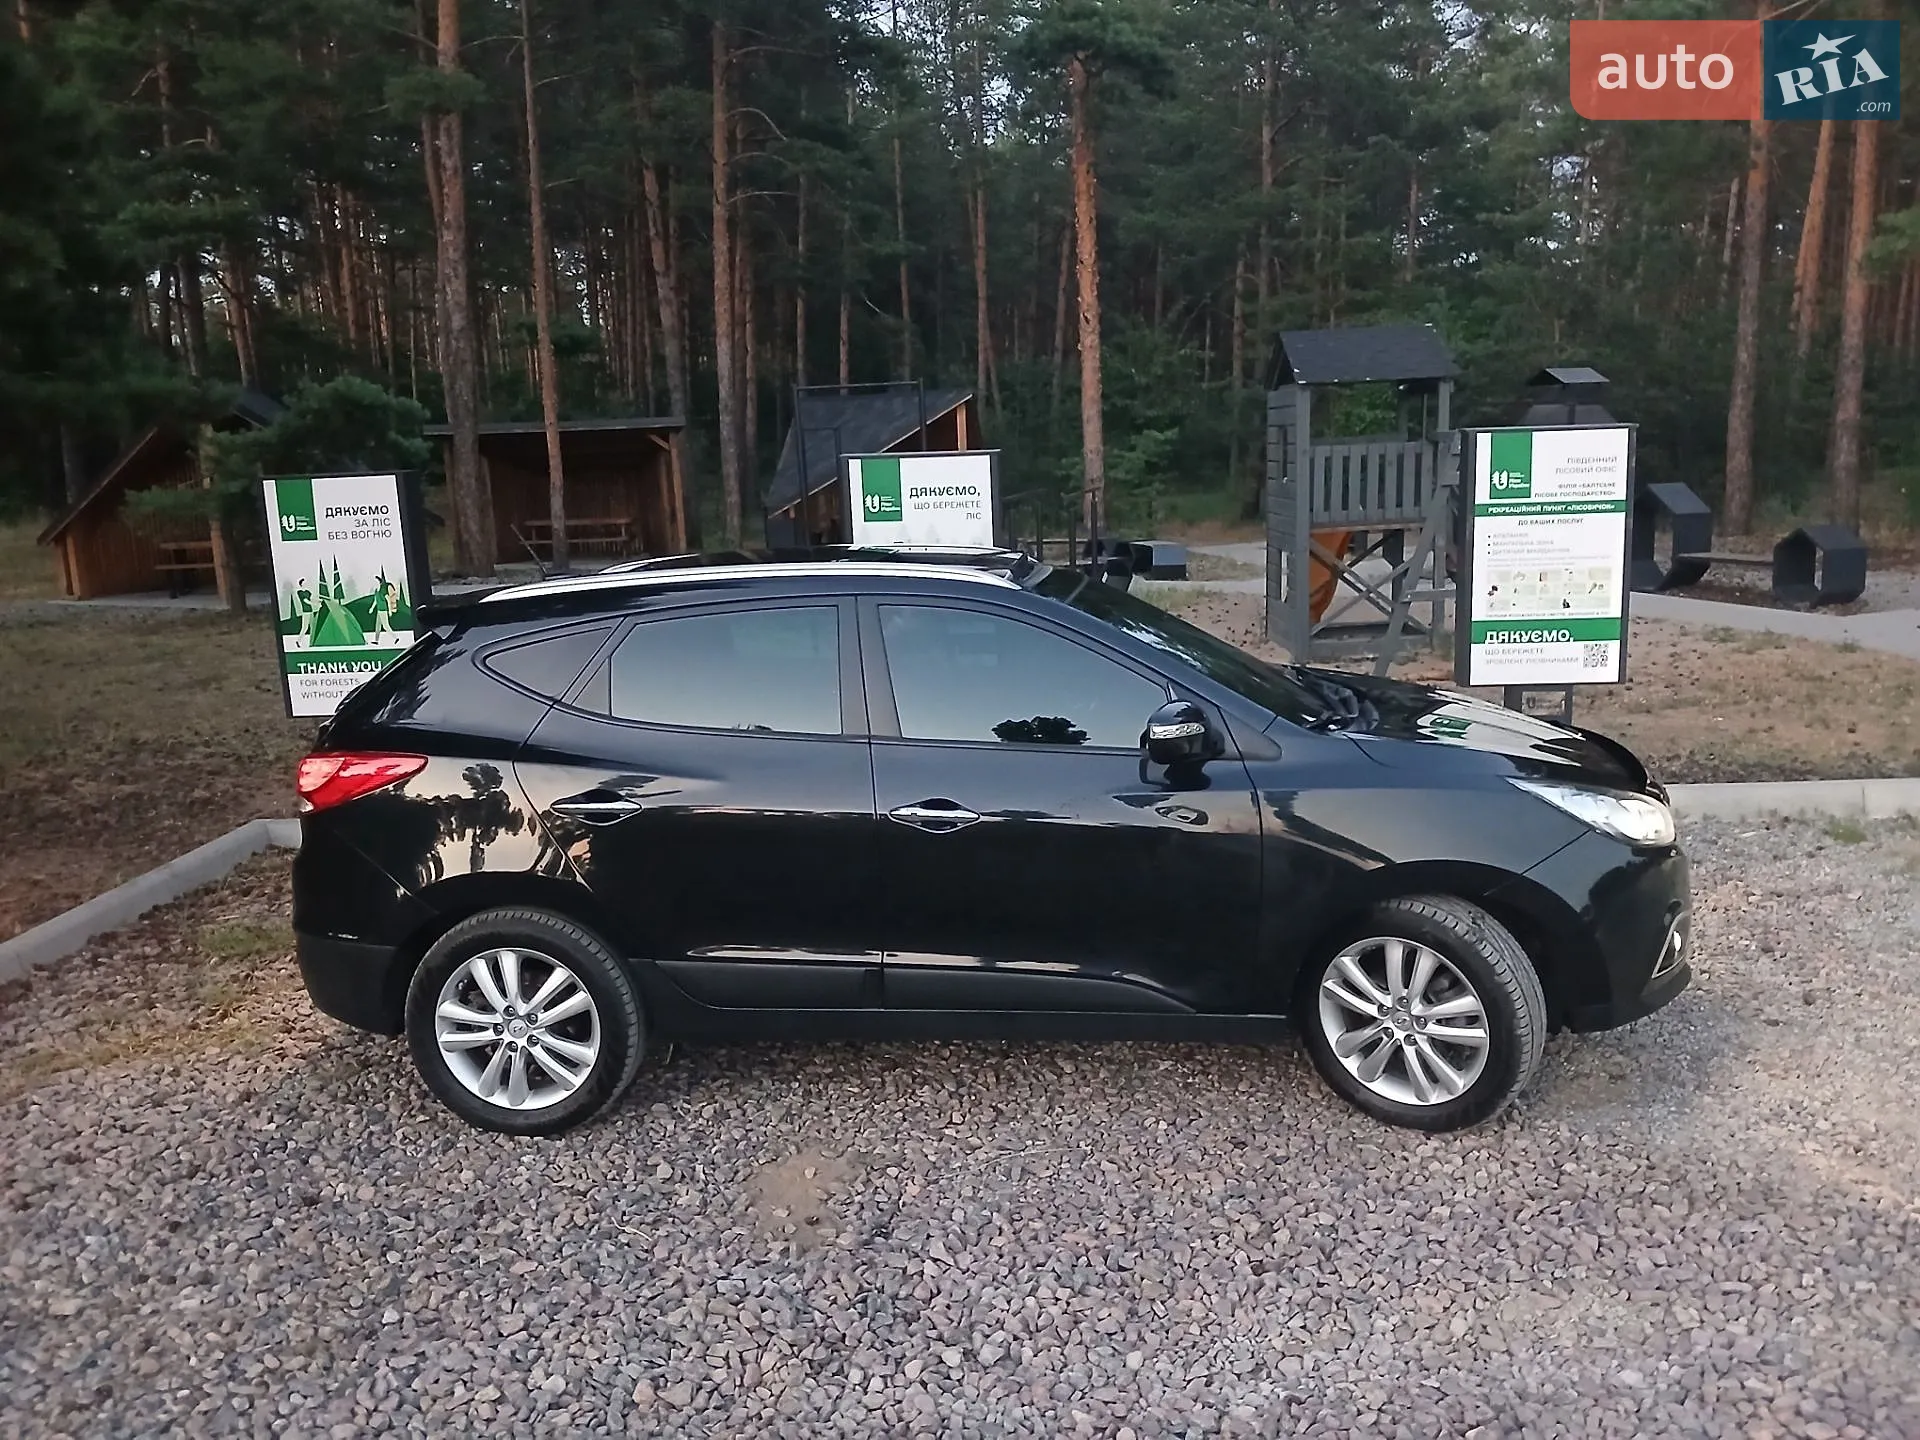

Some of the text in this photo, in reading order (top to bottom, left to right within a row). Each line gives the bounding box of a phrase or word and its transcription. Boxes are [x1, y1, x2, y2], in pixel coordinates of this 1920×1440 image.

[909, 486, 981, 499] ДЯКУЄМО,
[913, 500, 981, 510] ЩО БЕРЕЖЕТЕ
[325, 504, 389, 518] ДЯКУЄМО
[965, 512, 982, 520] ЛІС
[354, 518, 391, 528] ЗА ЛІС
[328, 529, 392, 540] БЕЗ ВОГНЮ
[1484, 630, 1574, 644] ДЯКУЄМО,
[297, 660, 382, 674] THANK YOU
[300, 678, 361, 687] FOR FORESTS
[301, 690, 343, 699] WITHOUT
